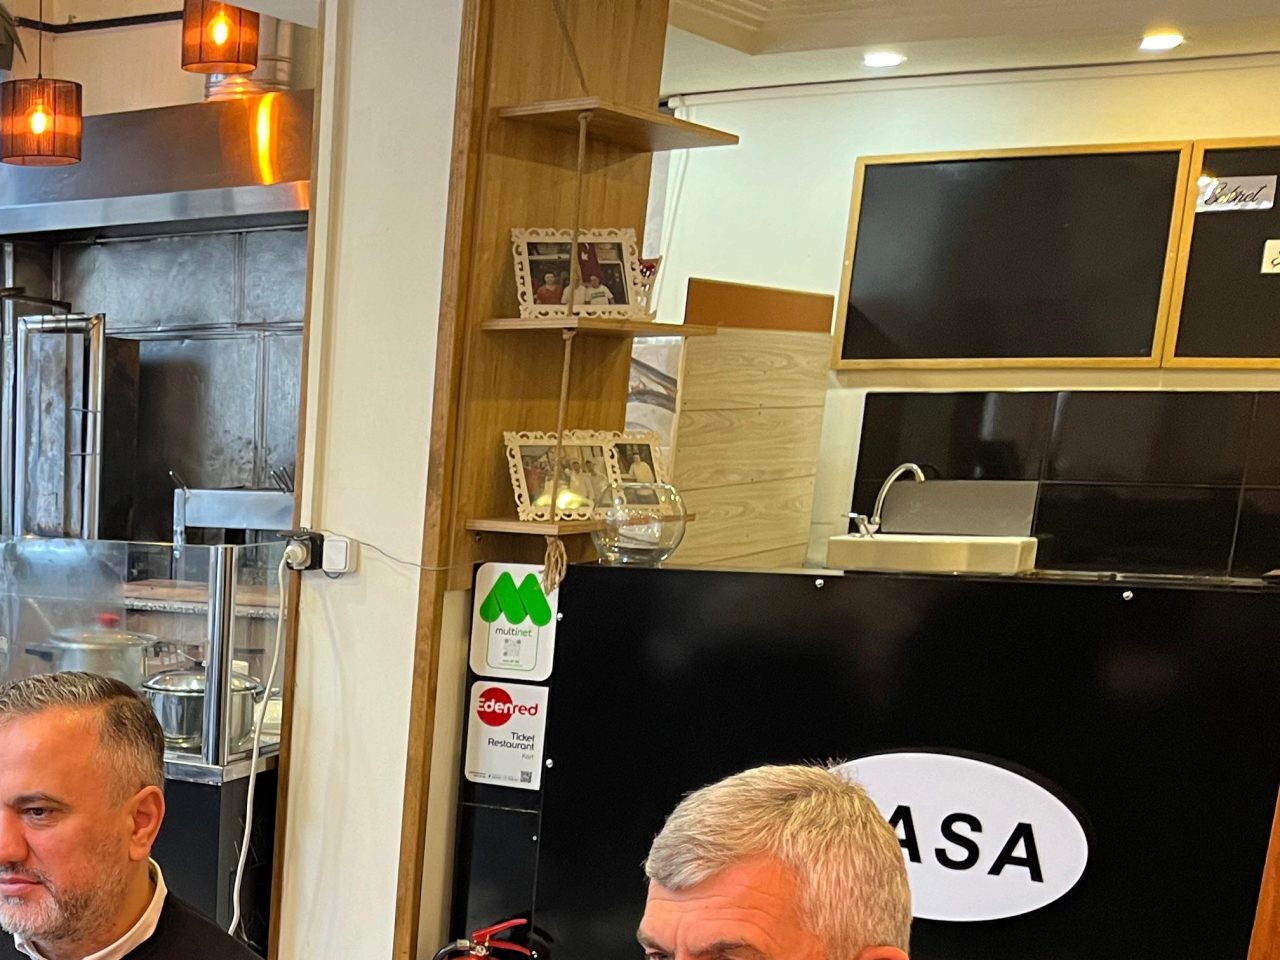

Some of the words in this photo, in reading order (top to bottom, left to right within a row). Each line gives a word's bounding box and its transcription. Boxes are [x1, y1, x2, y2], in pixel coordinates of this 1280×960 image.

[495, 626, 532, 637] multinet
[477, 698, 539, 716] Edenred
[511, 731, 535, 742] Ticket
[487, 737, 535, 751] Restaurant
[888, 804, 1044, 883] ASA
